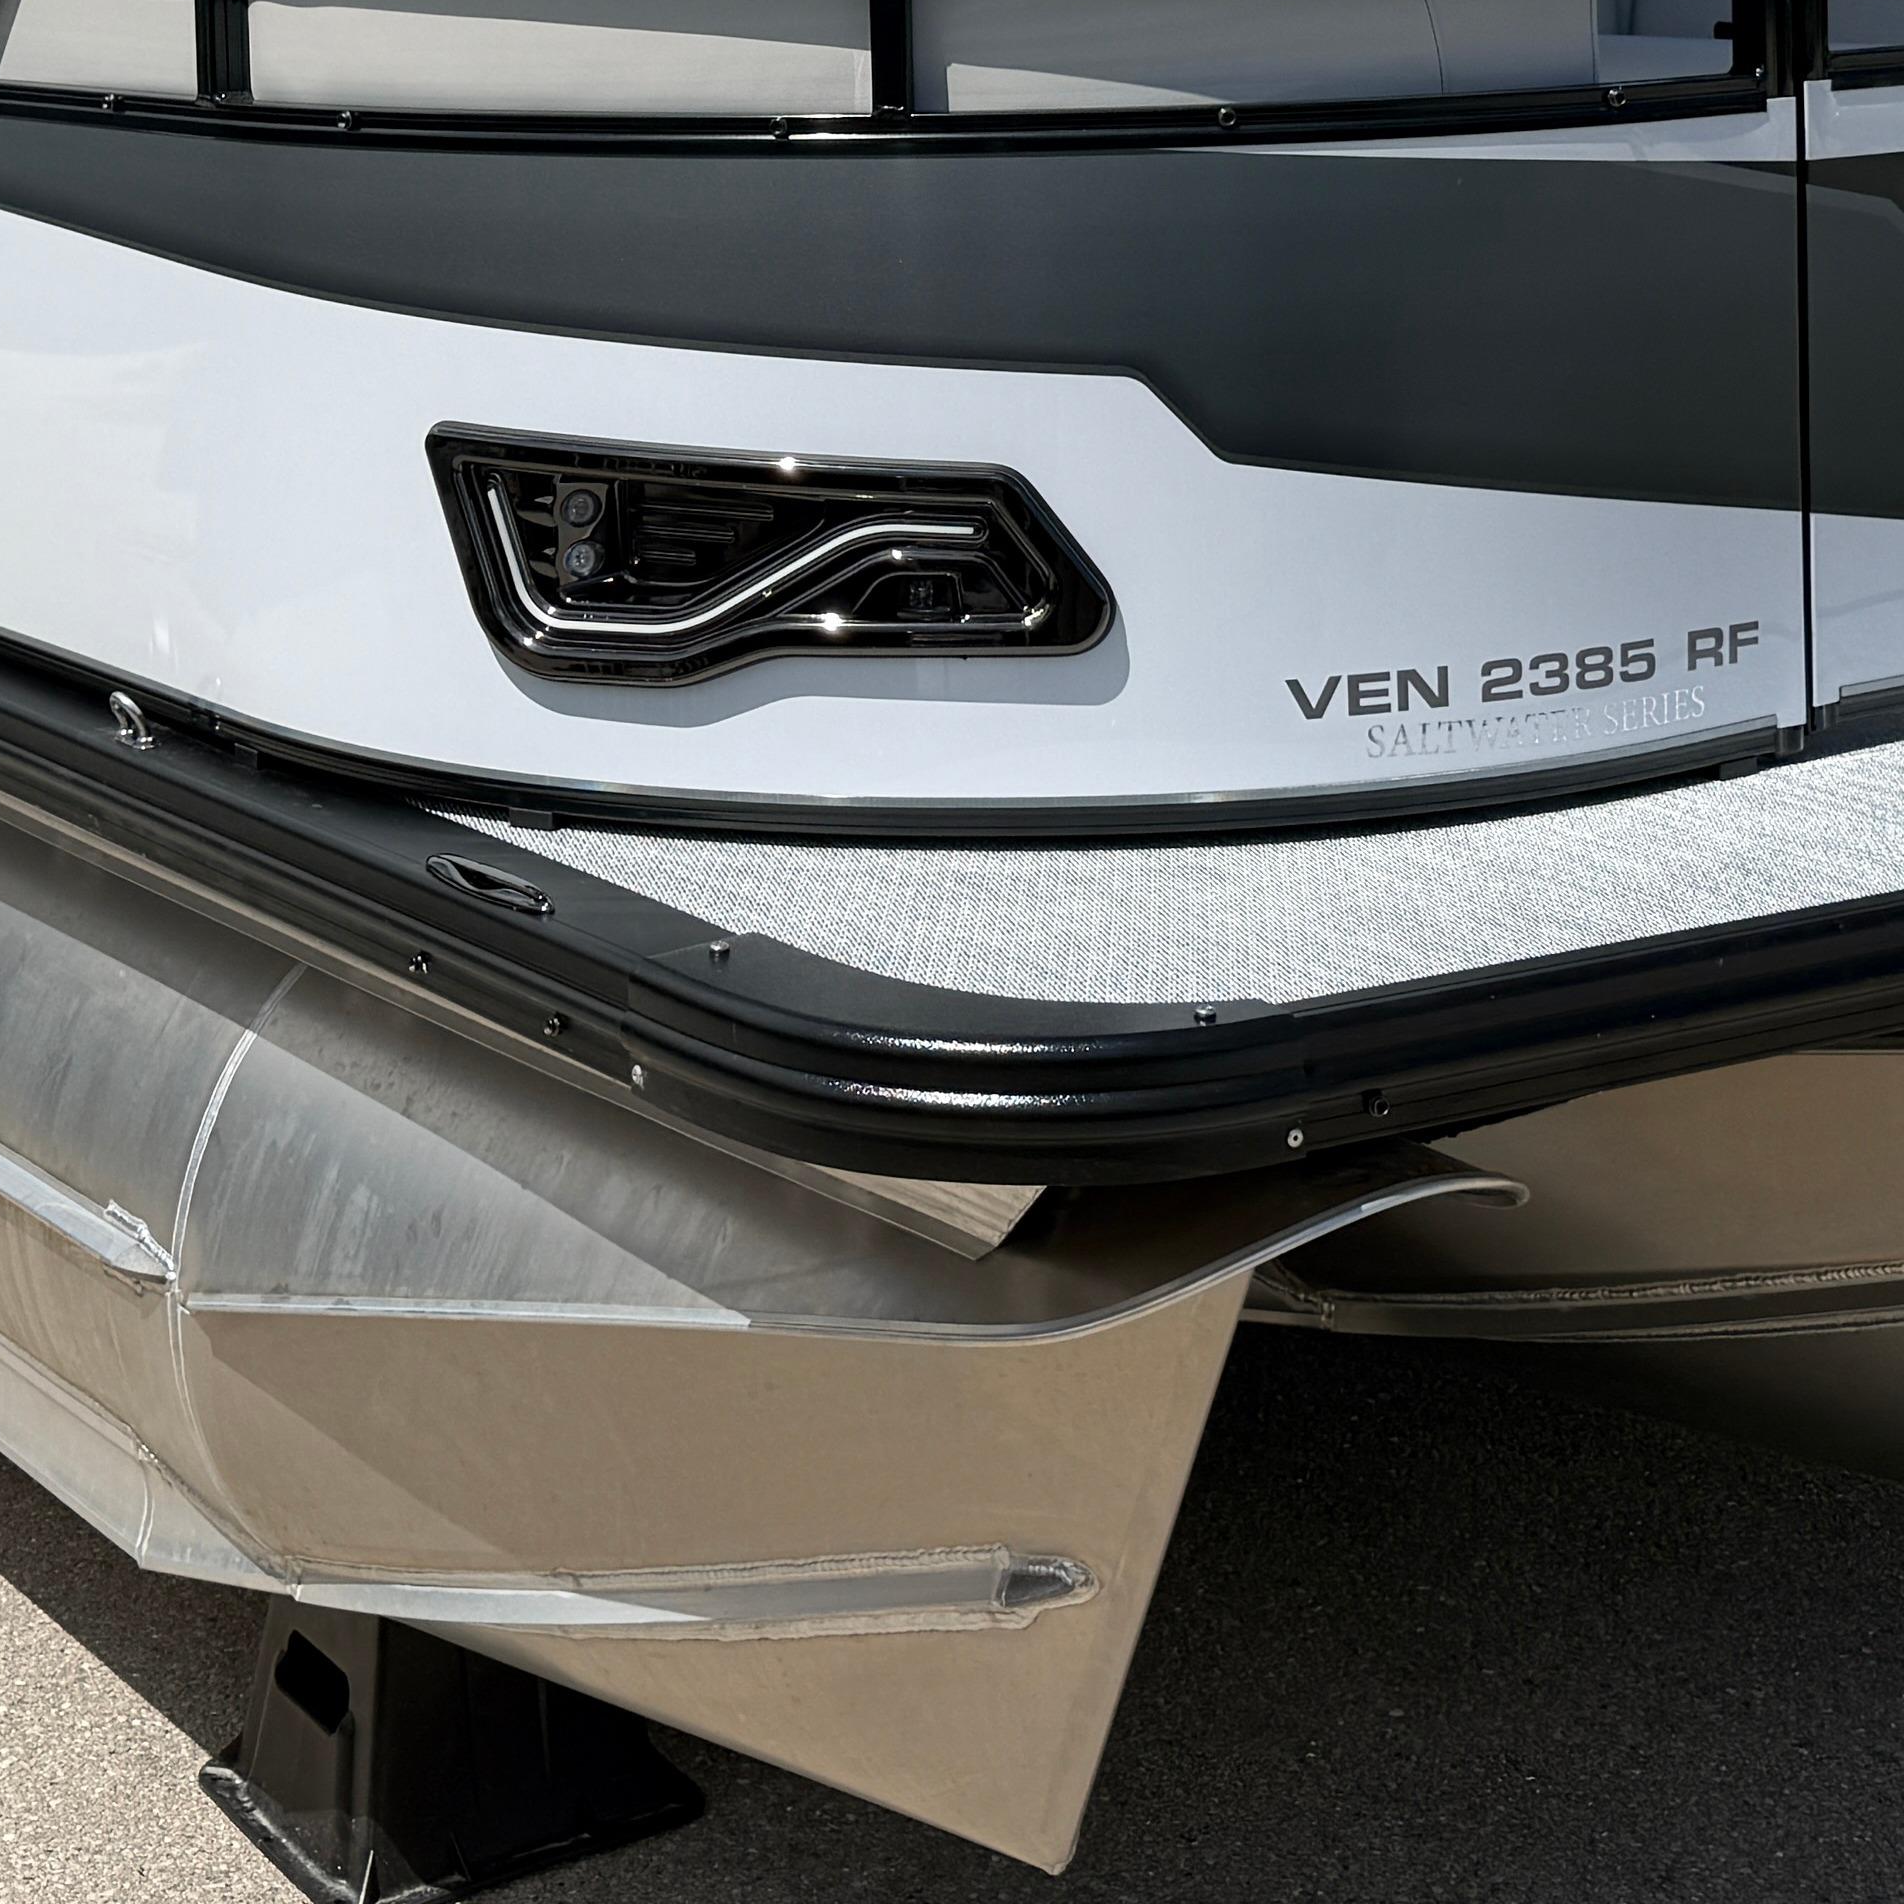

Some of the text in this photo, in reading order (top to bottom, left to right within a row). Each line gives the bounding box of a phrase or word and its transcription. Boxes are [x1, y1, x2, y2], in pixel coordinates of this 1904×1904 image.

[1285, 621, 1760, 721] VEN 2385 RF
[1367, 685, 1706, 759] SALTWATER SERIES
